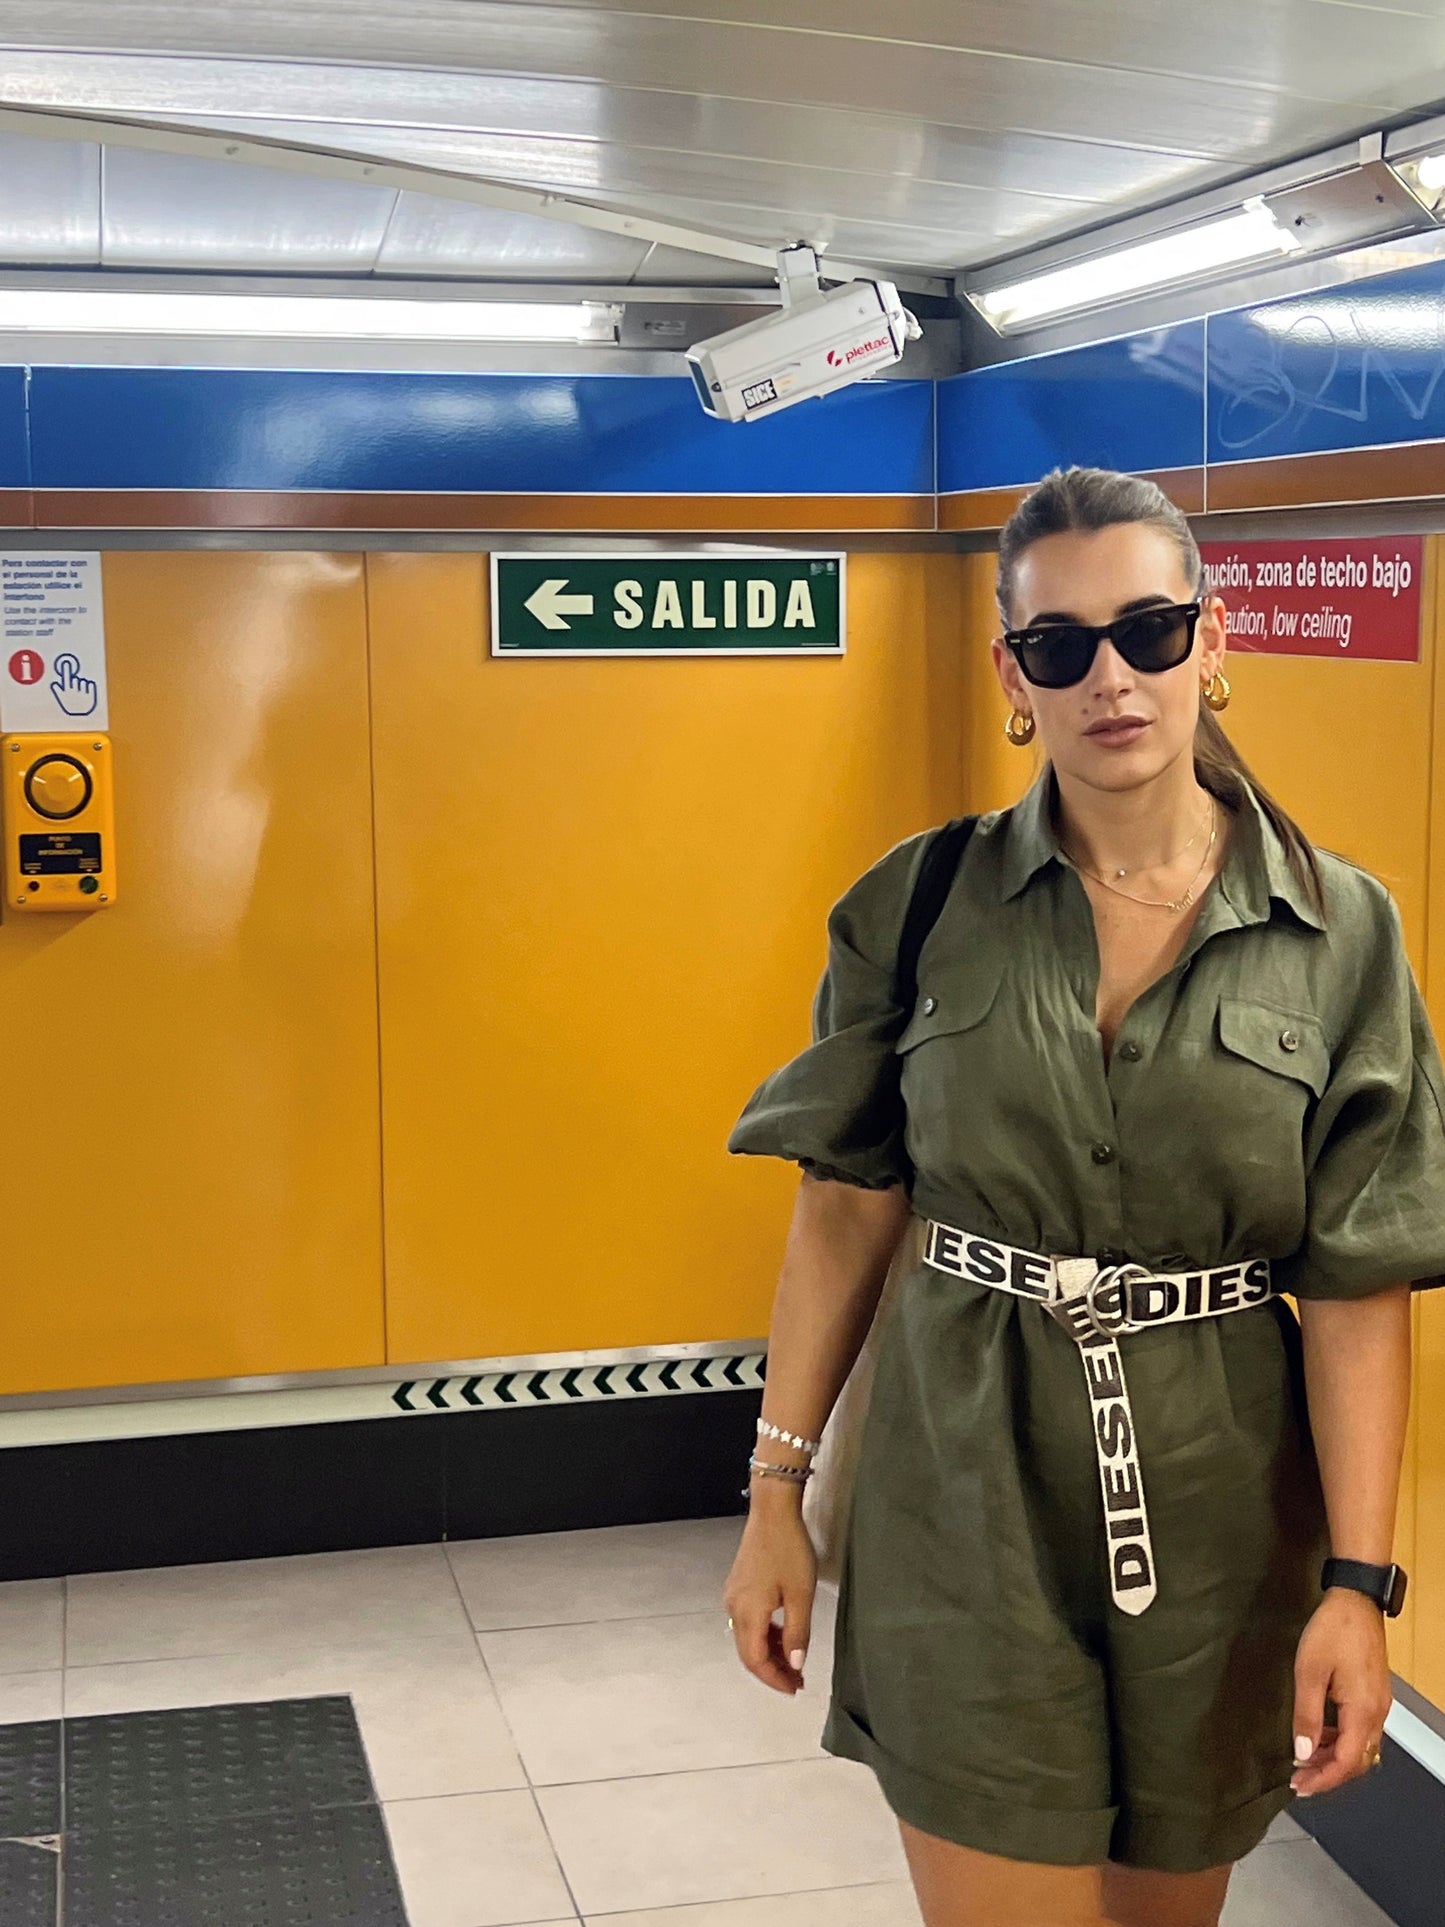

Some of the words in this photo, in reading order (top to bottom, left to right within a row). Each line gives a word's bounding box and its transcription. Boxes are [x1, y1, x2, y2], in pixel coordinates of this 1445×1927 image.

[846, 336, 890, 364] plettac
[743, 380, 776, 408] SICE
[1202, 554, 1253, 593] aución,
[1256, 561, 1292, 588] zona
[1296, 555, 1317, 588] de
[1320, 554, 1368, 588] techo
[1372, 553, 1412, 598] bajo
[612, 579, 817, 630] SALIDA
[1225, 604, 1268, 641] aution,
[1272, 605, 1300, 637] low
[1301, 606, 1353, 648] ceiling
